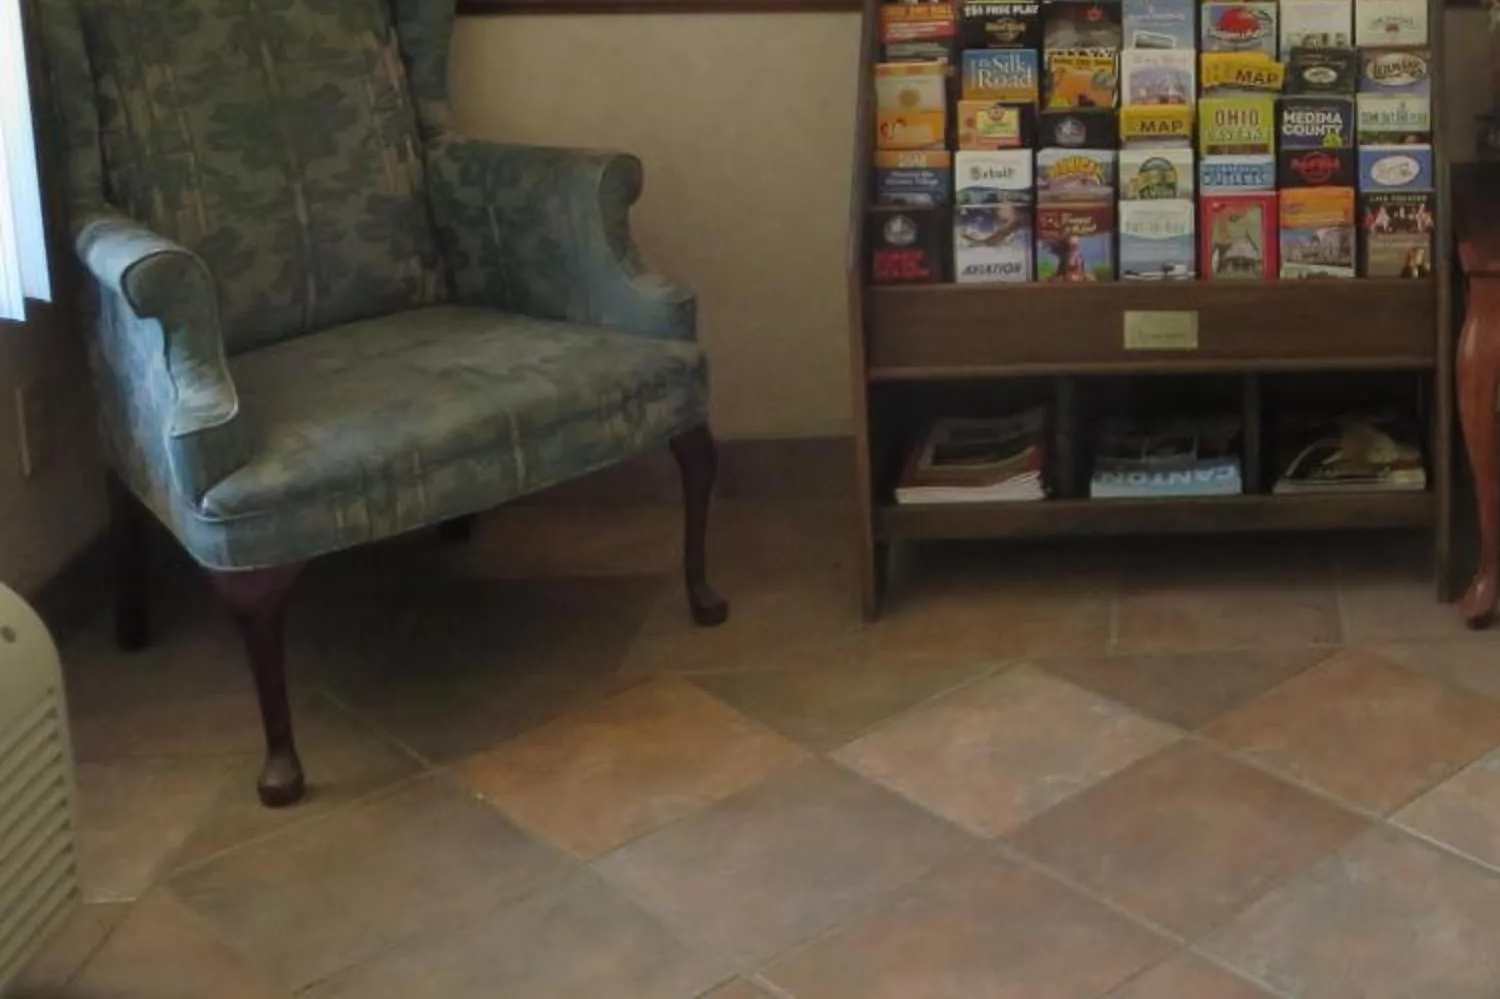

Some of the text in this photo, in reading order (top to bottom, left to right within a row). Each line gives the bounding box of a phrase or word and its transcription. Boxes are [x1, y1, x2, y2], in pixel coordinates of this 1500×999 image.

[1012, 4, 1040, 15] PLAY
[992, 53, 1026, 71] Silk
[978, 64, 1032, 89] Road
[1235, 69, 1280, 84] MAP
[1215, 110, 1259, 127] OHIO
[1283, 110, 1343, 123] MEDINA
[1139, 120, 1184, 133] MAP
[1282, 124, 1343, 136] COUNTY
